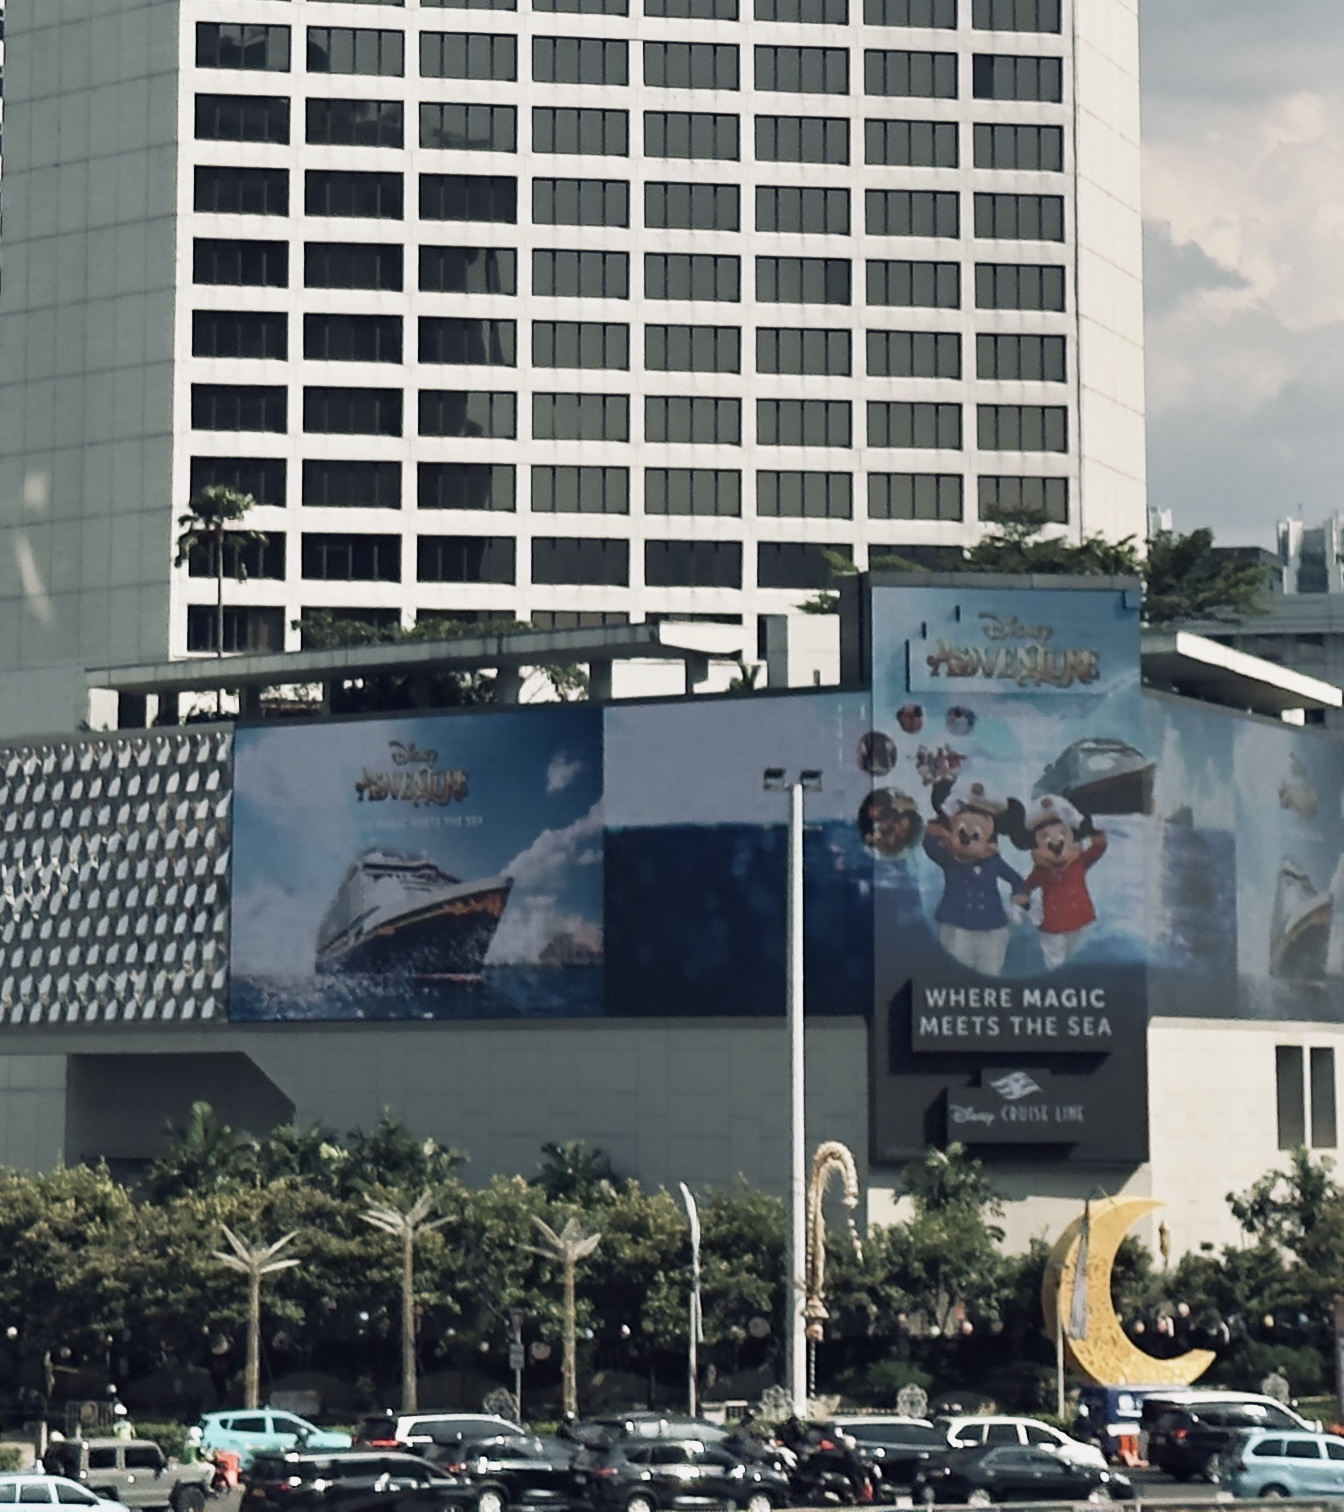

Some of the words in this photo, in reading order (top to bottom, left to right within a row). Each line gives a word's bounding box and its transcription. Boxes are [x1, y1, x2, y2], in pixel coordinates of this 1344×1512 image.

[978, 611, 1054, 647] Disney
[925, 987, 1012, 1008] WHERE
[1022, 987, 1106, 1008] MAGIC
[918, 1015, 1001, 1037] MEETS
[1010, 1015, 1058, 1036] THE
[1067, 1015, 1113, 1037] SEA
[949, 1104, 996, 1127] Disney
[1000, 1103, 1049, 1123] CRUISE
[1056, 1104, 1085, 1123] LINE
